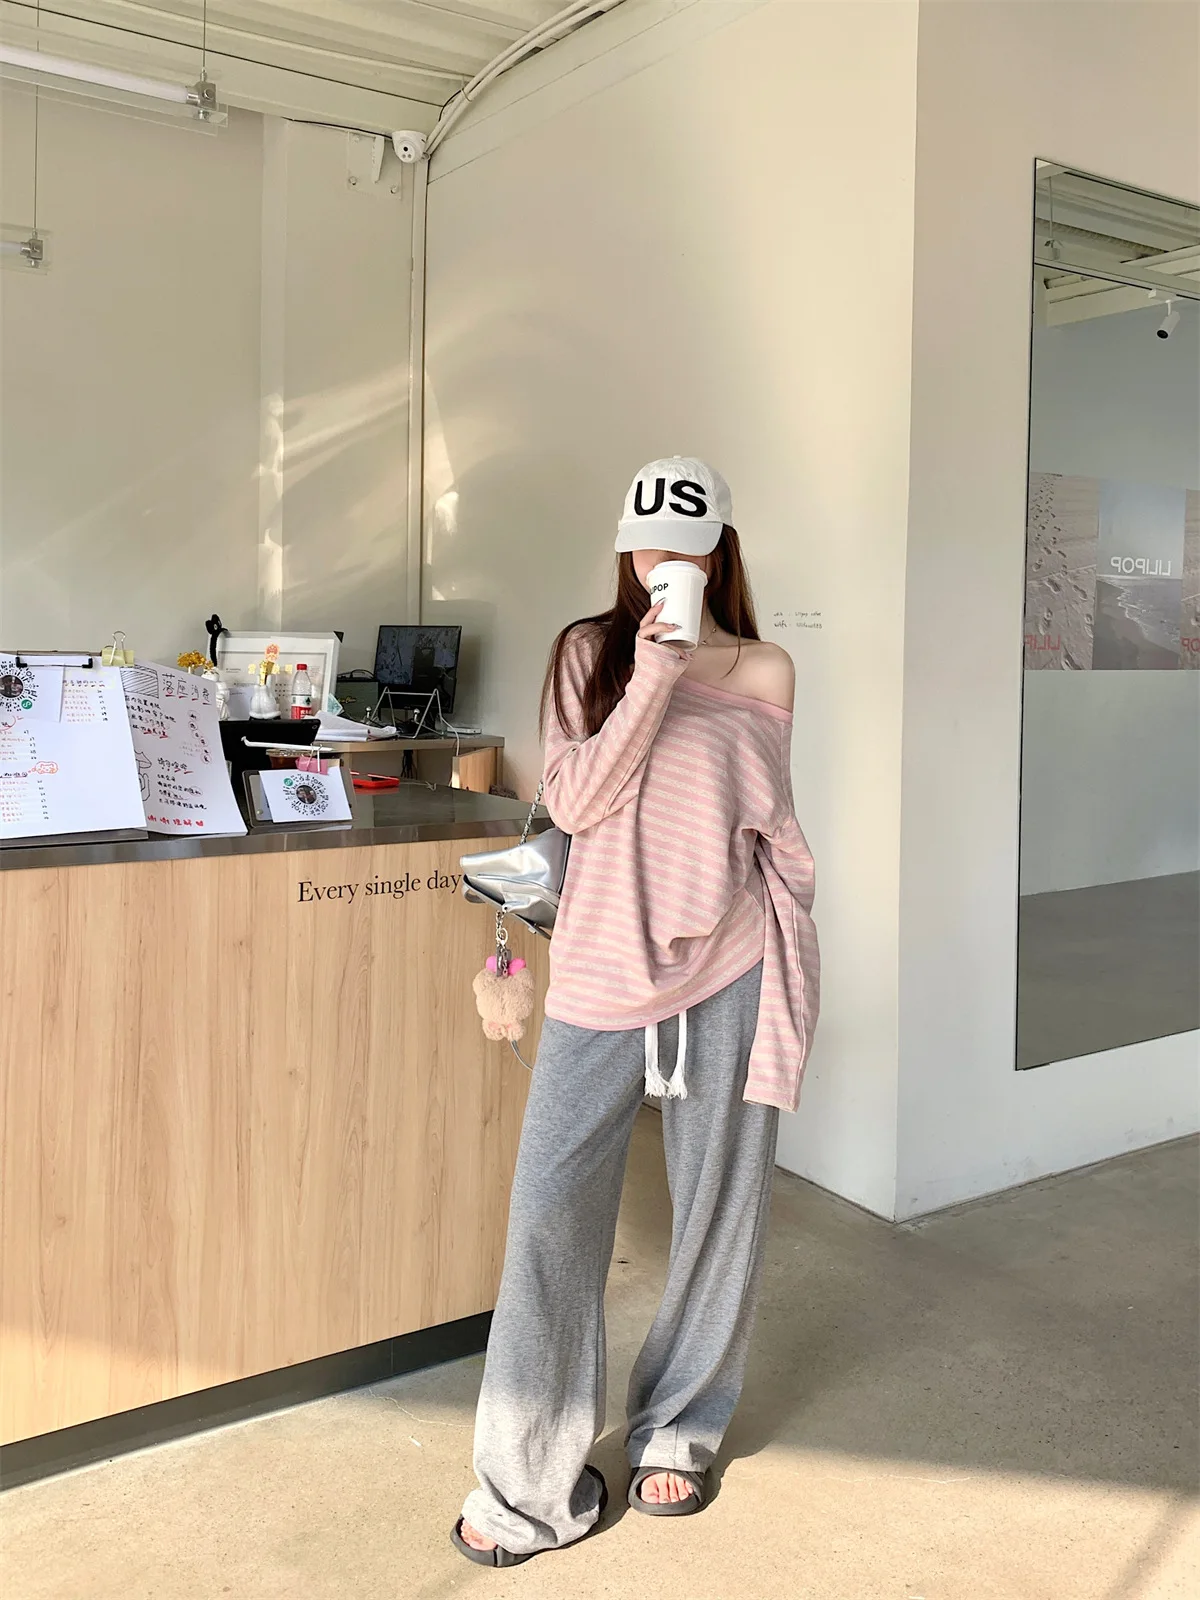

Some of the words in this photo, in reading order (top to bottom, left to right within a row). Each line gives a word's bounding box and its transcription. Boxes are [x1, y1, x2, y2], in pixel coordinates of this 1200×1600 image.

[634, 478, 708, 517] US
[297, 881, 360, 904] Every
[364, 872, 422, 899] single
[426, 870, 462, 893] day
